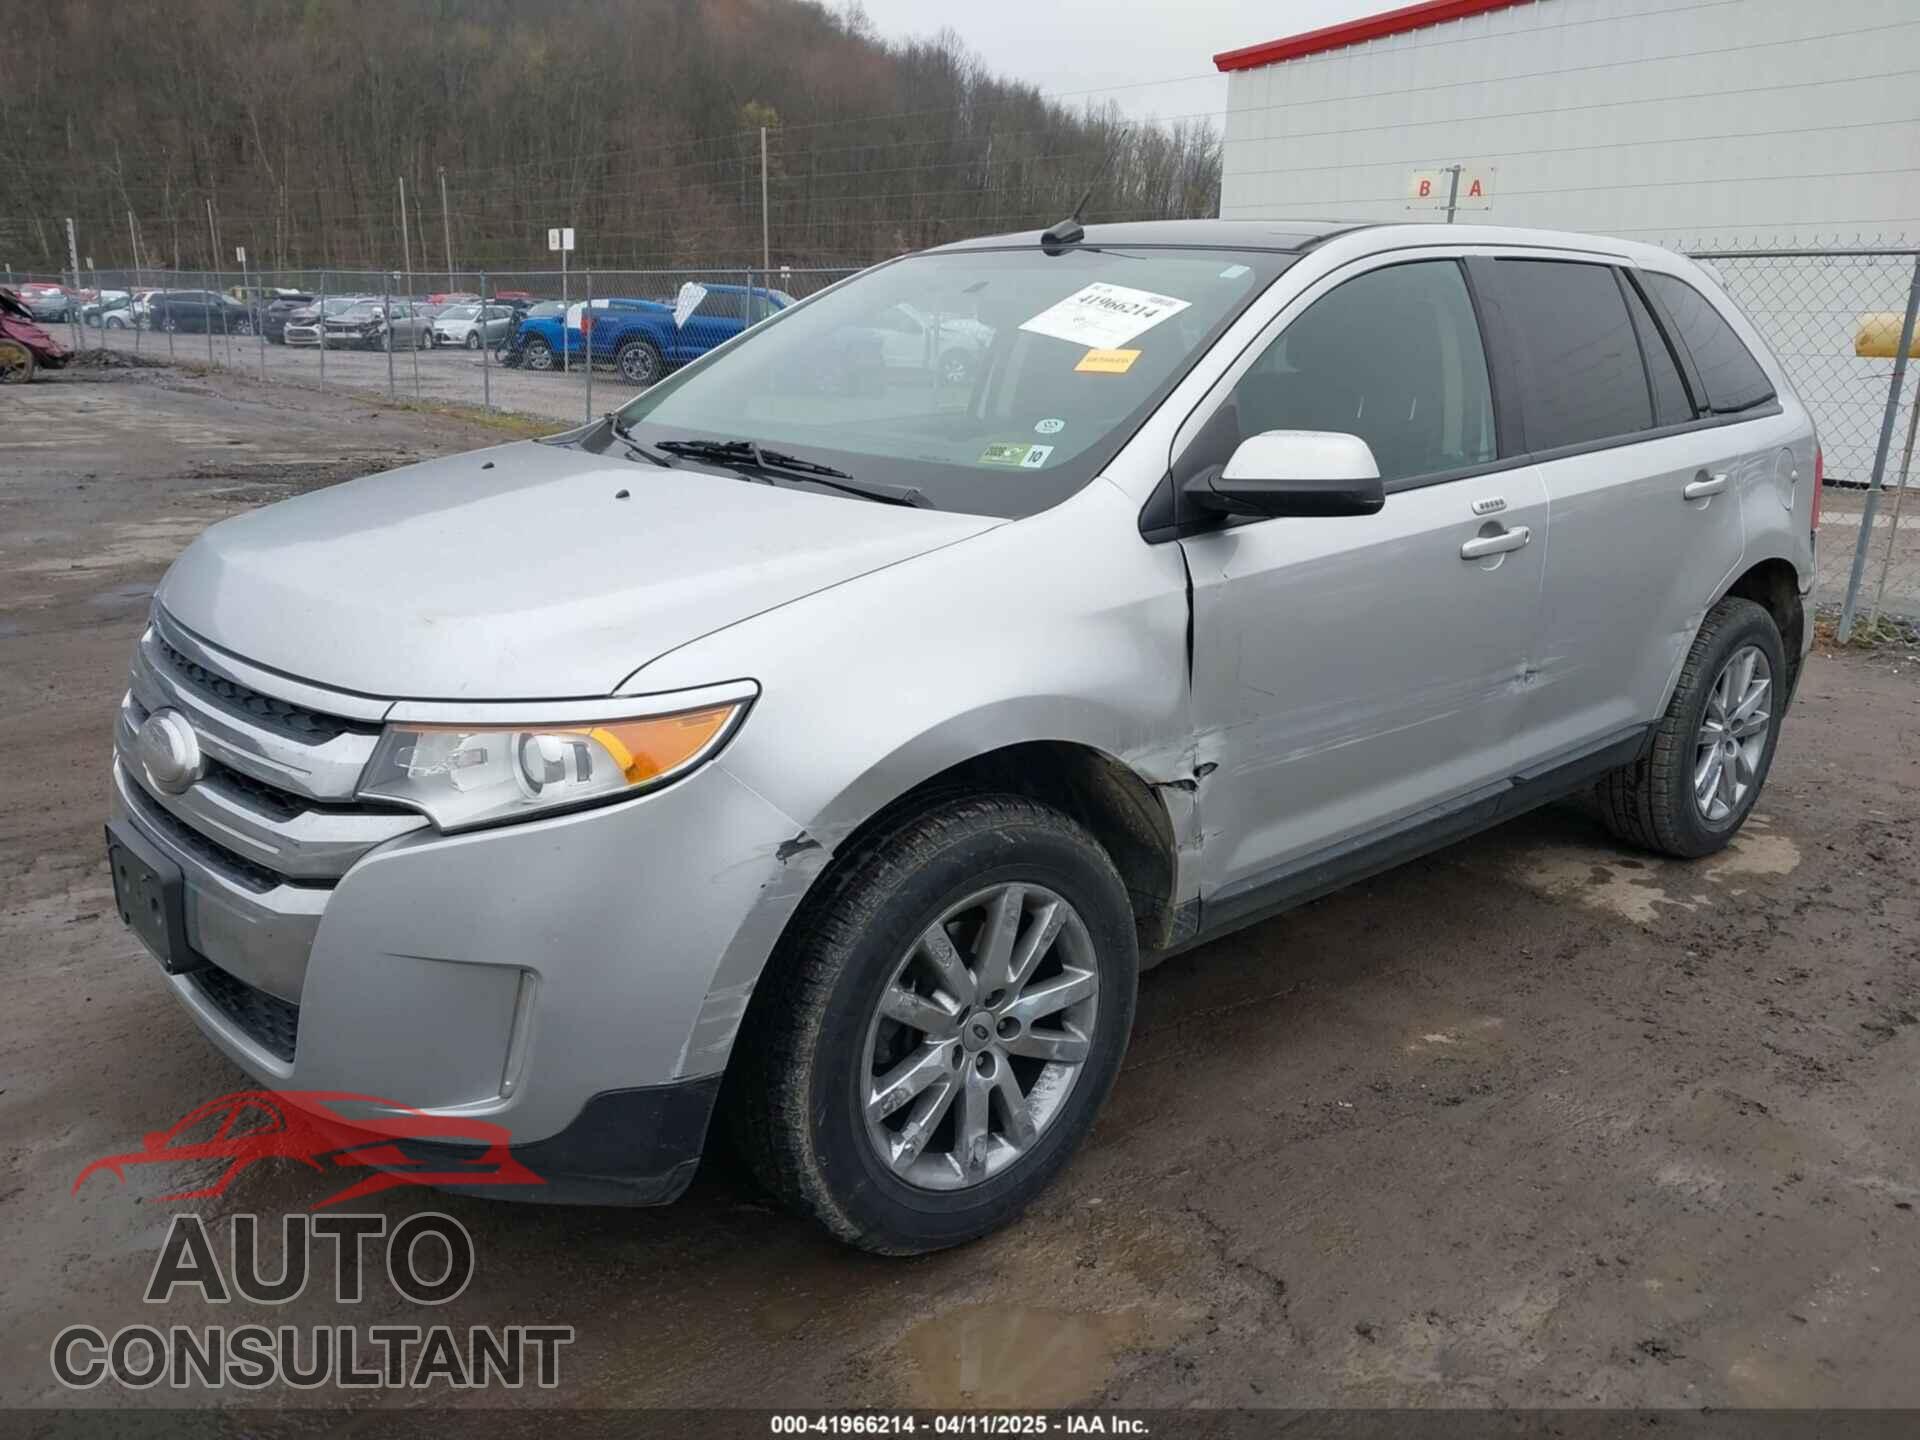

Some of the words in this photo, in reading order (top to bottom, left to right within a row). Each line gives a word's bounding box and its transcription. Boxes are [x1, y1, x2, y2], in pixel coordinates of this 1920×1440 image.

[1419, 180, 1431, 197] B
[1469, 179, 1481, 197] A
[1080, 294, 1160, 318] 41966214
[1027, 450, 1043, 463] 10
